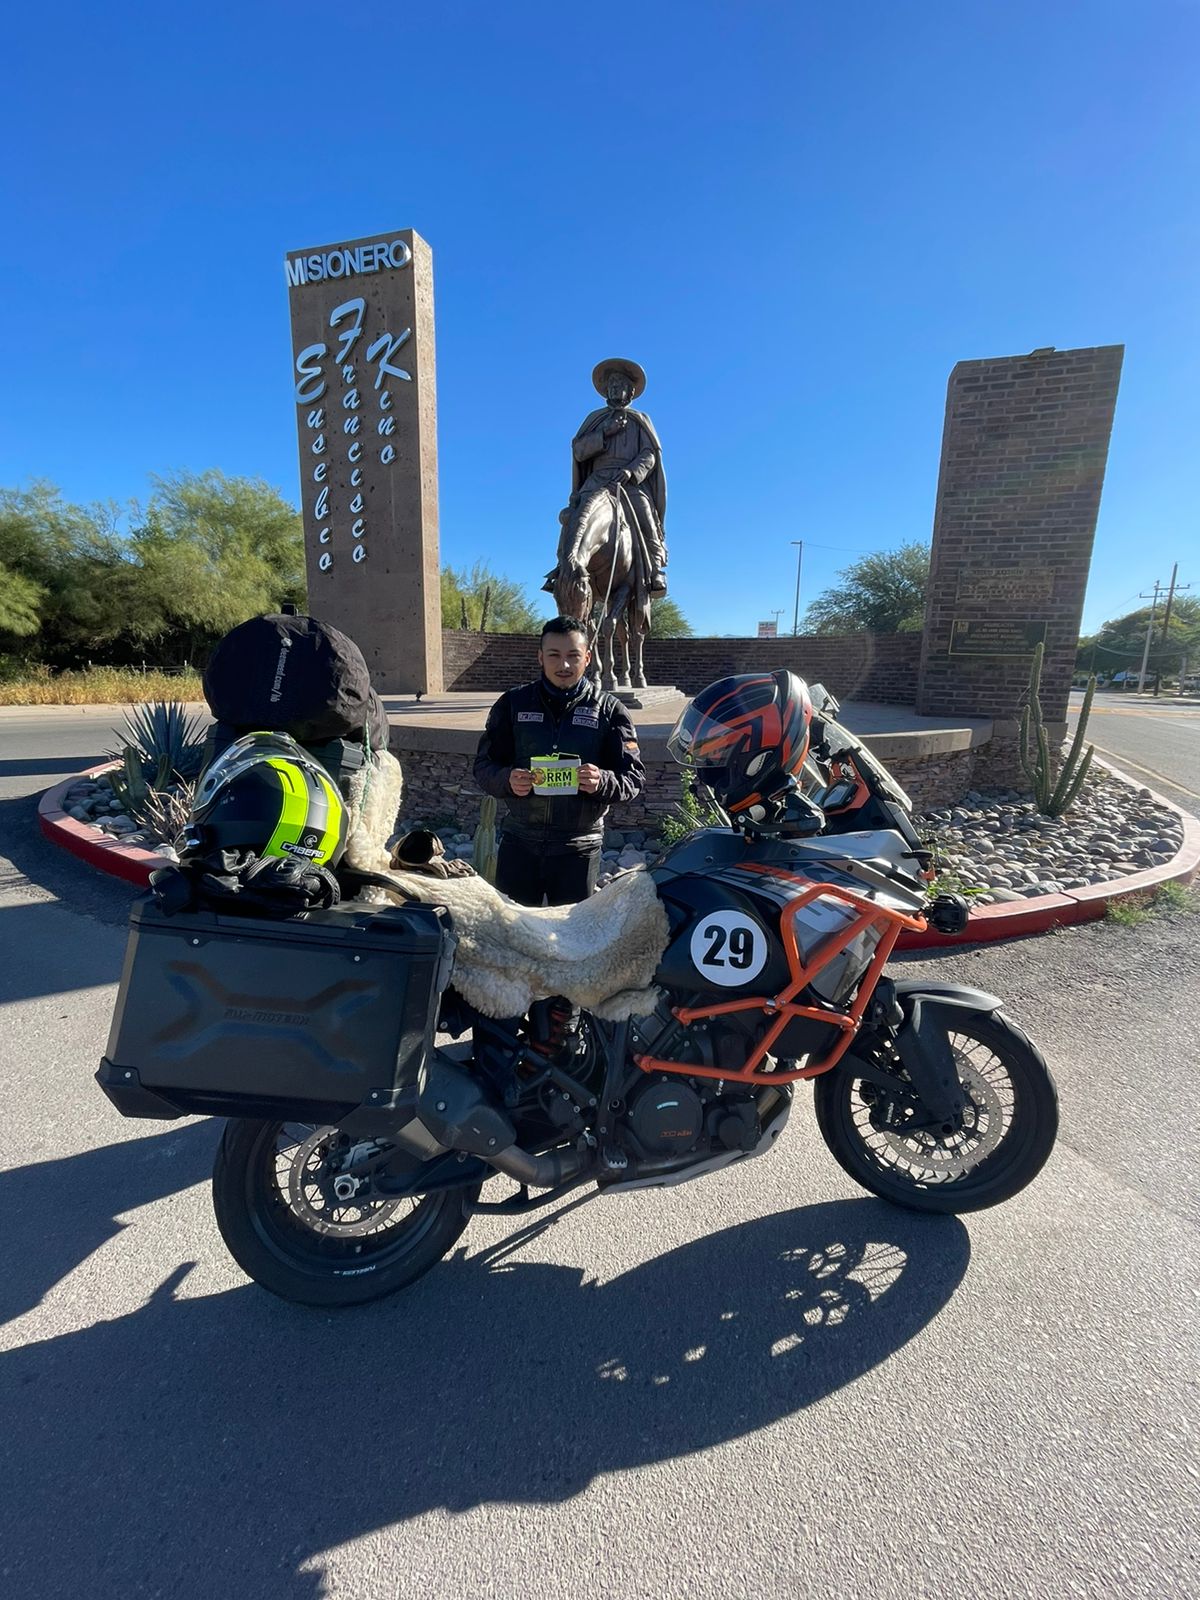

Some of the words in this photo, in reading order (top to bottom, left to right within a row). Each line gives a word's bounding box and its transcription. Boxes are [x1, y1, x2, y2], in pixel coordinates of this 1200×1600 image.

[285, 239, 412, 287] MISIONERO
[329, 297, 367, 563] Francisco
[366, 327, 412, 465] Kino
[295, 343, 333, 571] Eusebio
[547, 771, 572, 782] RRM
[702, 925, 754, 969] 29
